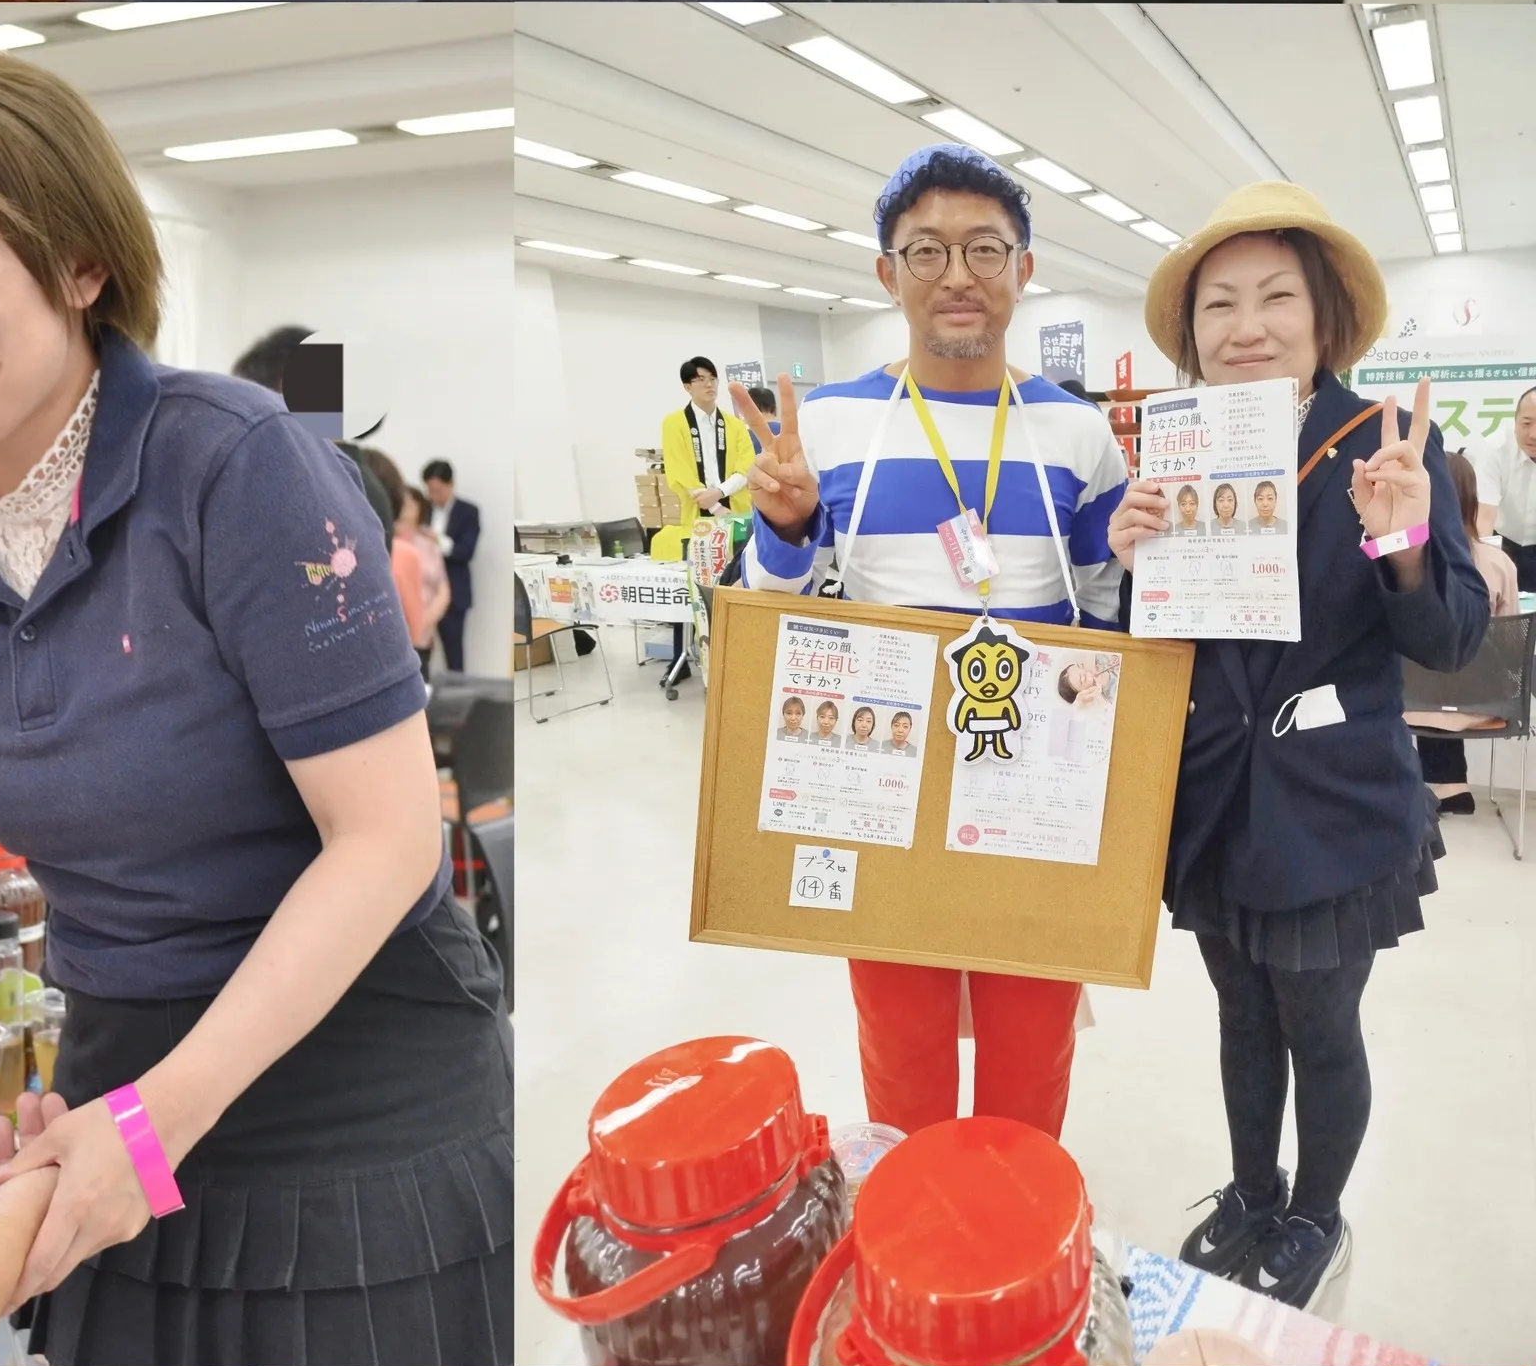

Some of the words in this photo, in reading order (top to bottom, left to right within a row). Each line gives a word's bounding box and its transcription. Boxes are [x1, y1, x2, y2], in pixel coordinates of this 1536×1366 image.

[1149, 412, 1207, 431] あなたの顔、
[1148, 429, 1212, 454] 左右同じ
[711, 530, 726, 574] カゴメ
[620, 586, 694, 606] 朝日生命
[788, 635, 857, 655] あなたの顔、
[787, 649, 861, 674] 左右同じ
[798, 855, 847, 873] ブースは
